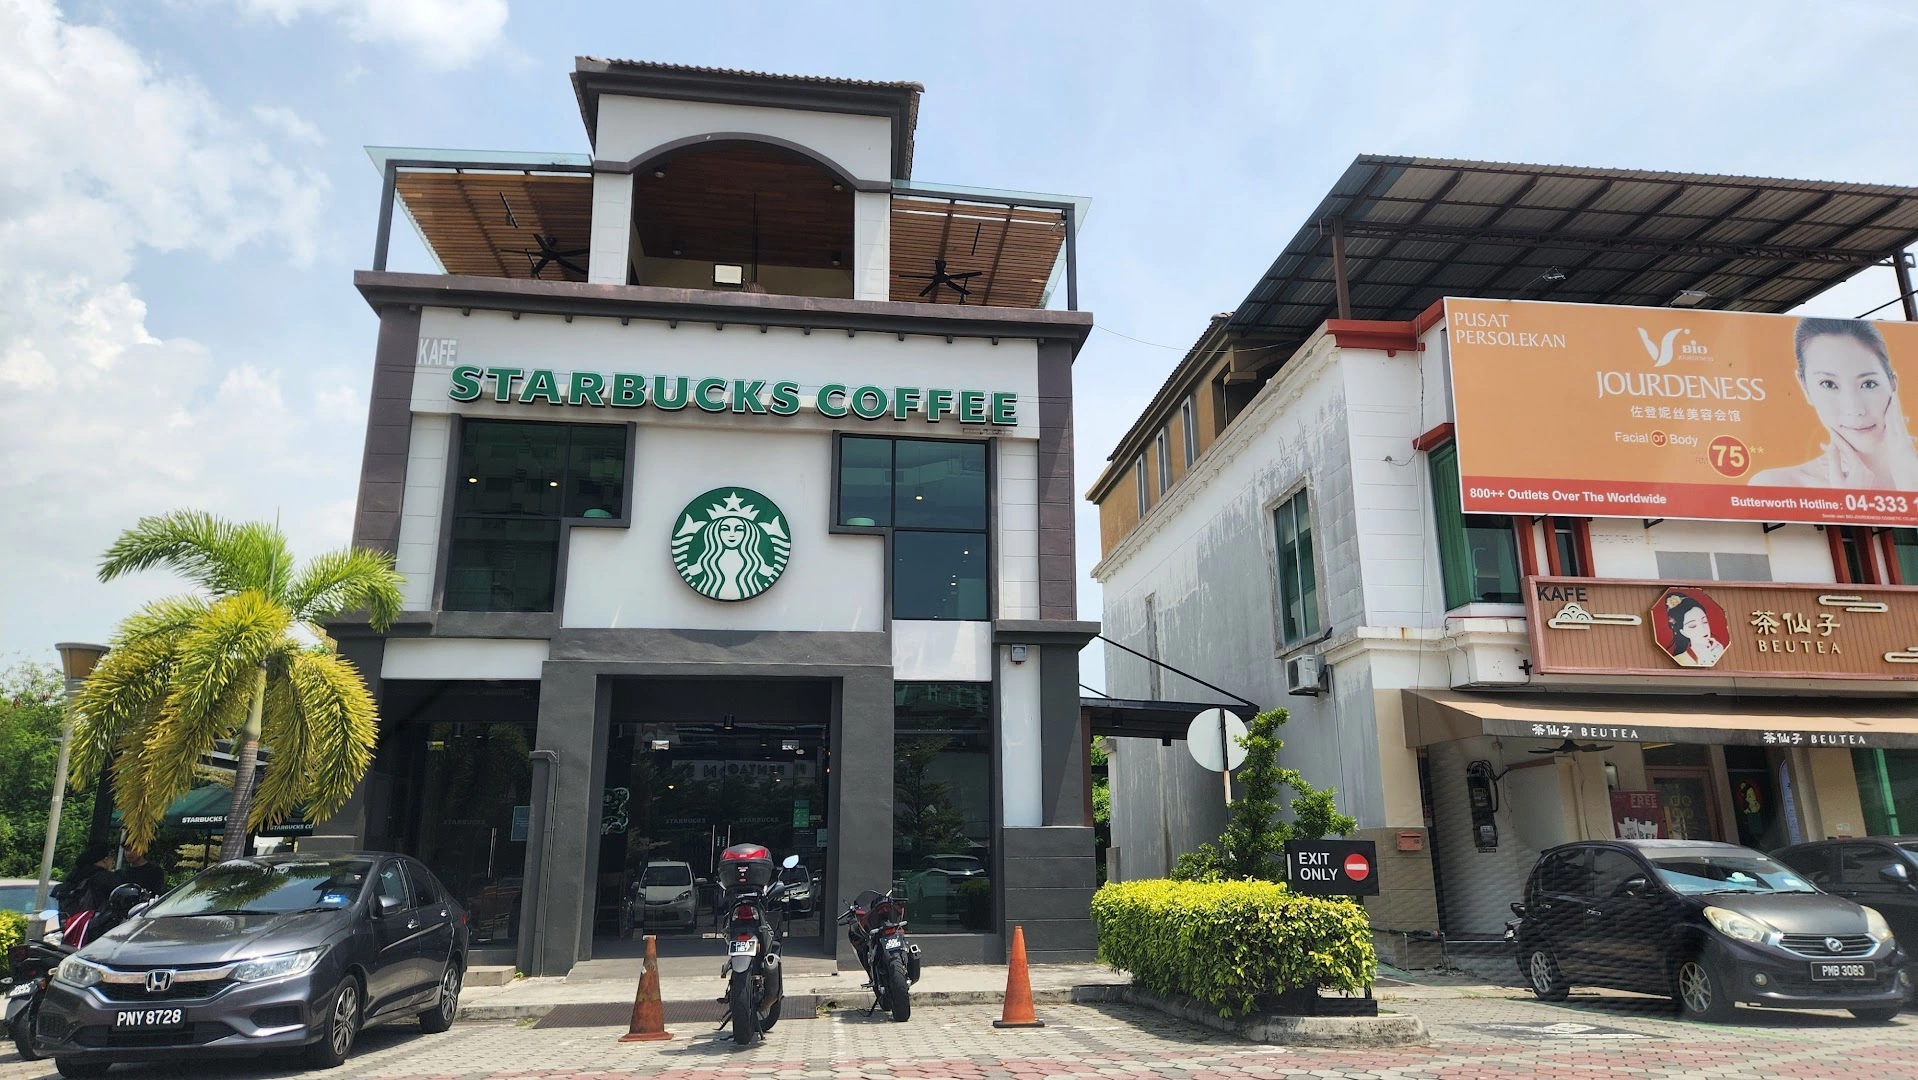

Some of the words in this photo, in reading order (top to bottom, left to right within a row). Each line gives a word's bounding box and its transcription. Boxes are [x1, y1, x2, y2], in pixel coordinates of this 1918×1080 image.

[1454, 312, 1509, 328] PUSAT
[1456, 329, 1566, 348] PERSOLEKAN
[418, 337, 457, 366] KAFE
[1596, 371, 1766, 401] JOURDENESS
[447, 364, 801, 417] STARBUCKS
[816, 383, 1018, 426] COFFEE
[1630, 405, 1741, 422] 佐登妮丝美容会馆
[1614, 432, 1649, 443] Facial
[1652, 434, 1664, 443] or
[1669, 434, 1698, 447] Body
[1469, 487, 1504, 498] 800++
[1507, 488, 1549, 500] Outlets
[1552, 490, 1580, 501] Over
[1582, 491, 1604, 502] The
[1607, 492, 1667, 504] Worldwide
[1730, 496, 1797, 509] Butterworth
[1845, 494, 1908, 513] 04-333
[1537, 586, 1588, 602] KAFE
[1749, 609, 1841, 637] 茶仙子
[1758, 639, 1841, 655] BEUTEA
[1531, 723, 1573, 738] 茶仙子
[1580, 727, 1639, 739] BEUTEA
[1763, 731, 1803, 745] 茶仙子
[1810, 734, 1866, 745] BEUTEA
[1631, 794, 1657, 807] FREE
[181, 815, 223, 823] STARBUCKS
[1298, 852, 1330, 865] EXIT
[1300, 868, 1338, 881] ONLY
[1821, 965, 1840, 976] PMB
[1841, 965, 1865, 976] 3083
[116, 1011, 145, 1027] PNY
[145, 1009, 182, 1025] 8728
